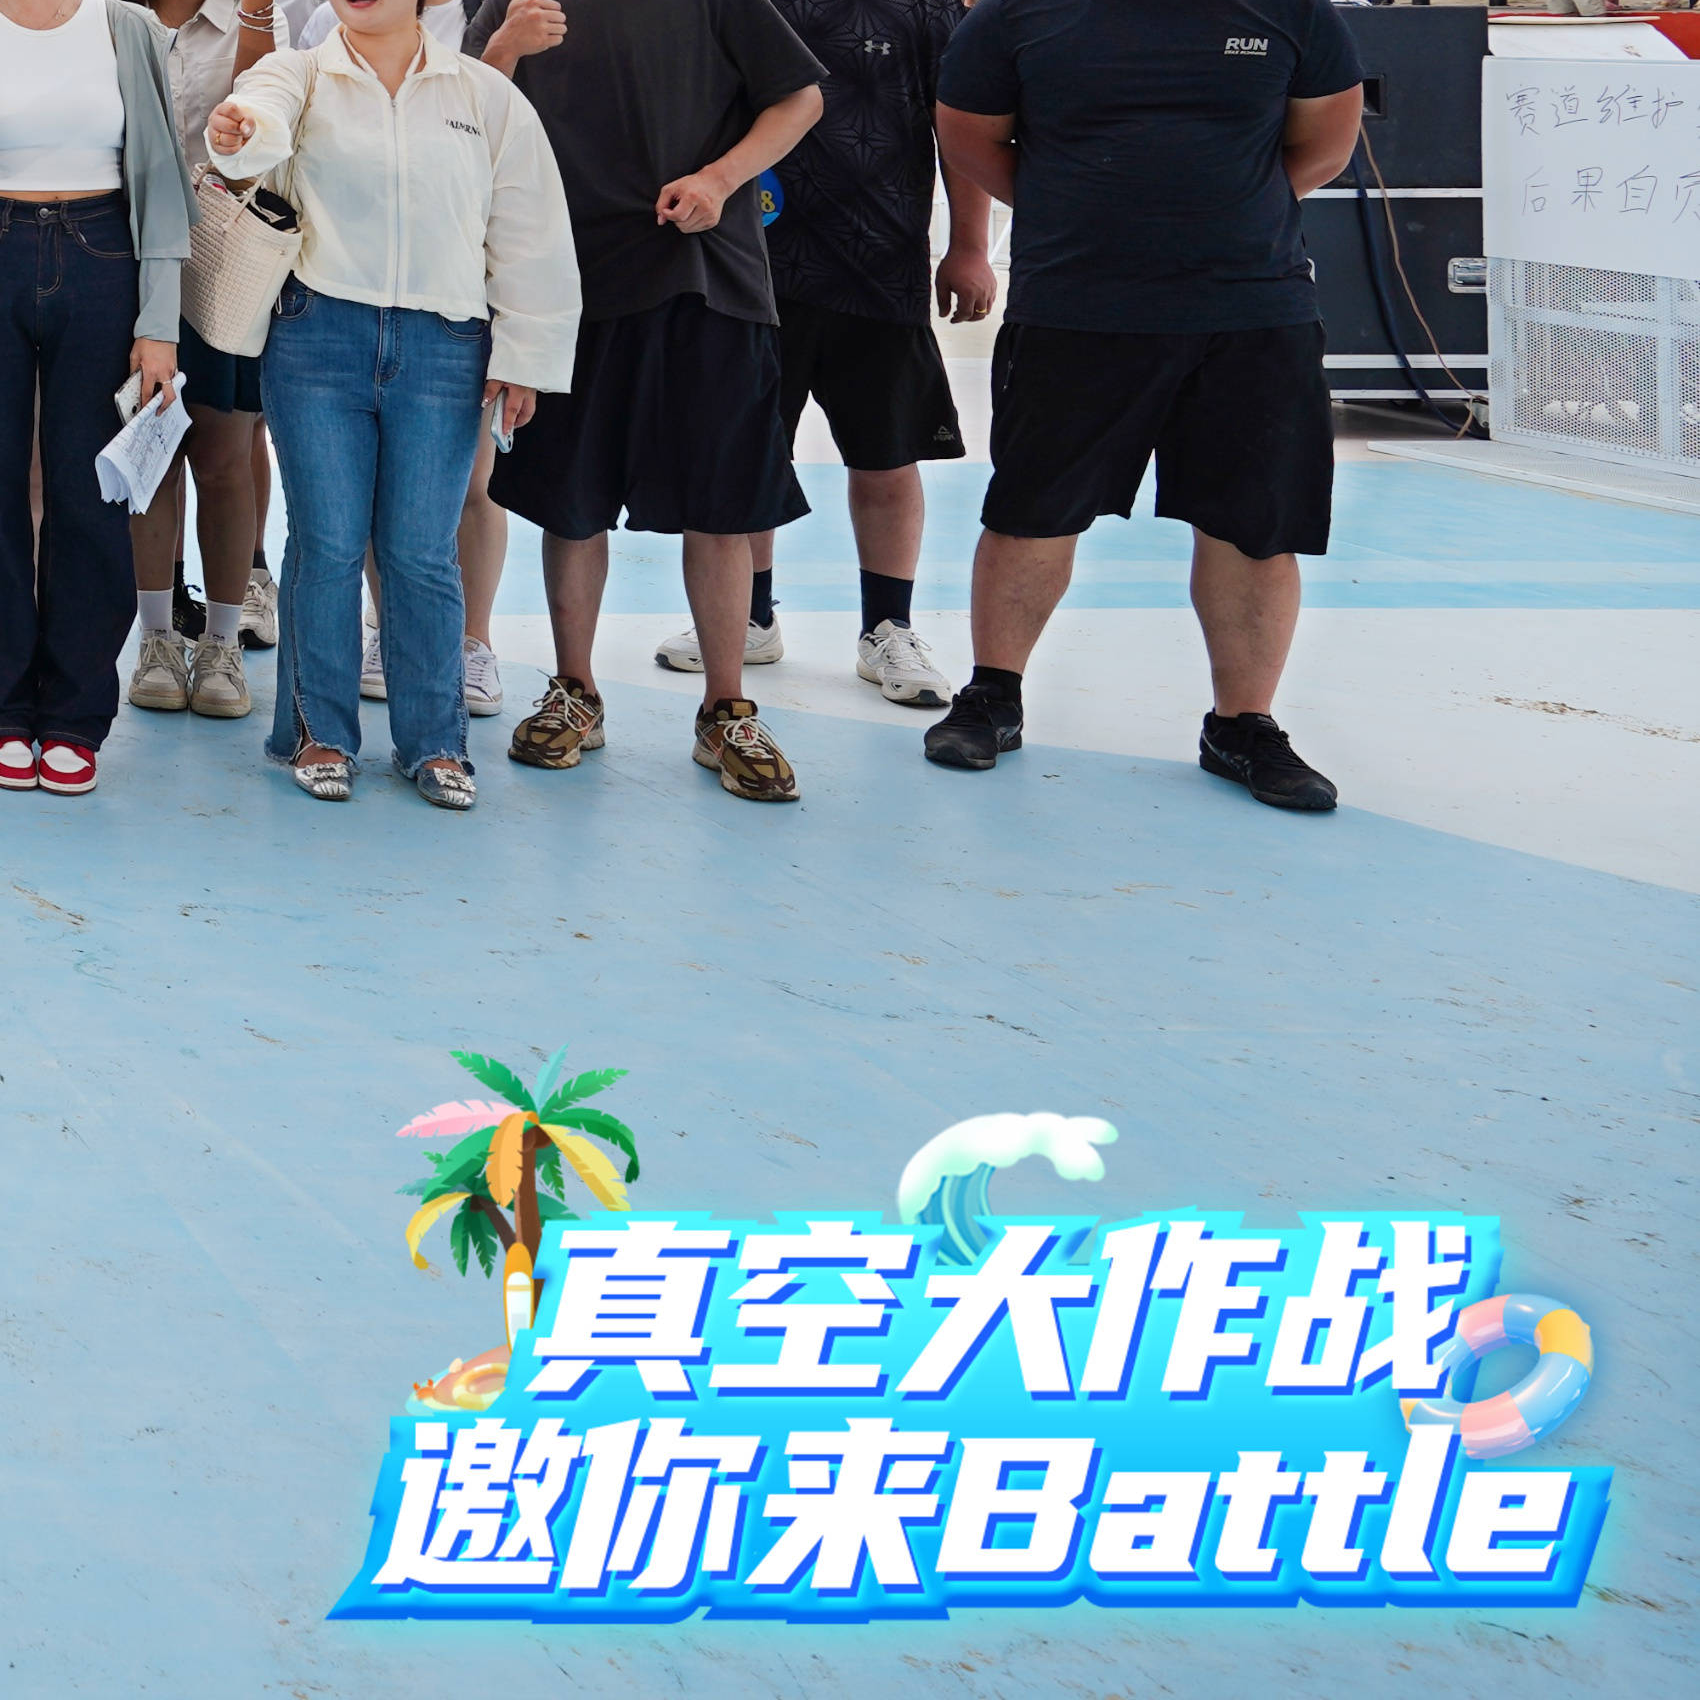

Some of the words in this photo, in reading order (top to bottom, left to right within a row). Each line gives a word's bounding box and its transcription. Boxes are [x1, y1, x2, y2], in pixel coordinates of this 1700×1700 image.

[1225, 37, 1269, 51] RUN
[1505, 84, 1700, 136] 赛道维护
